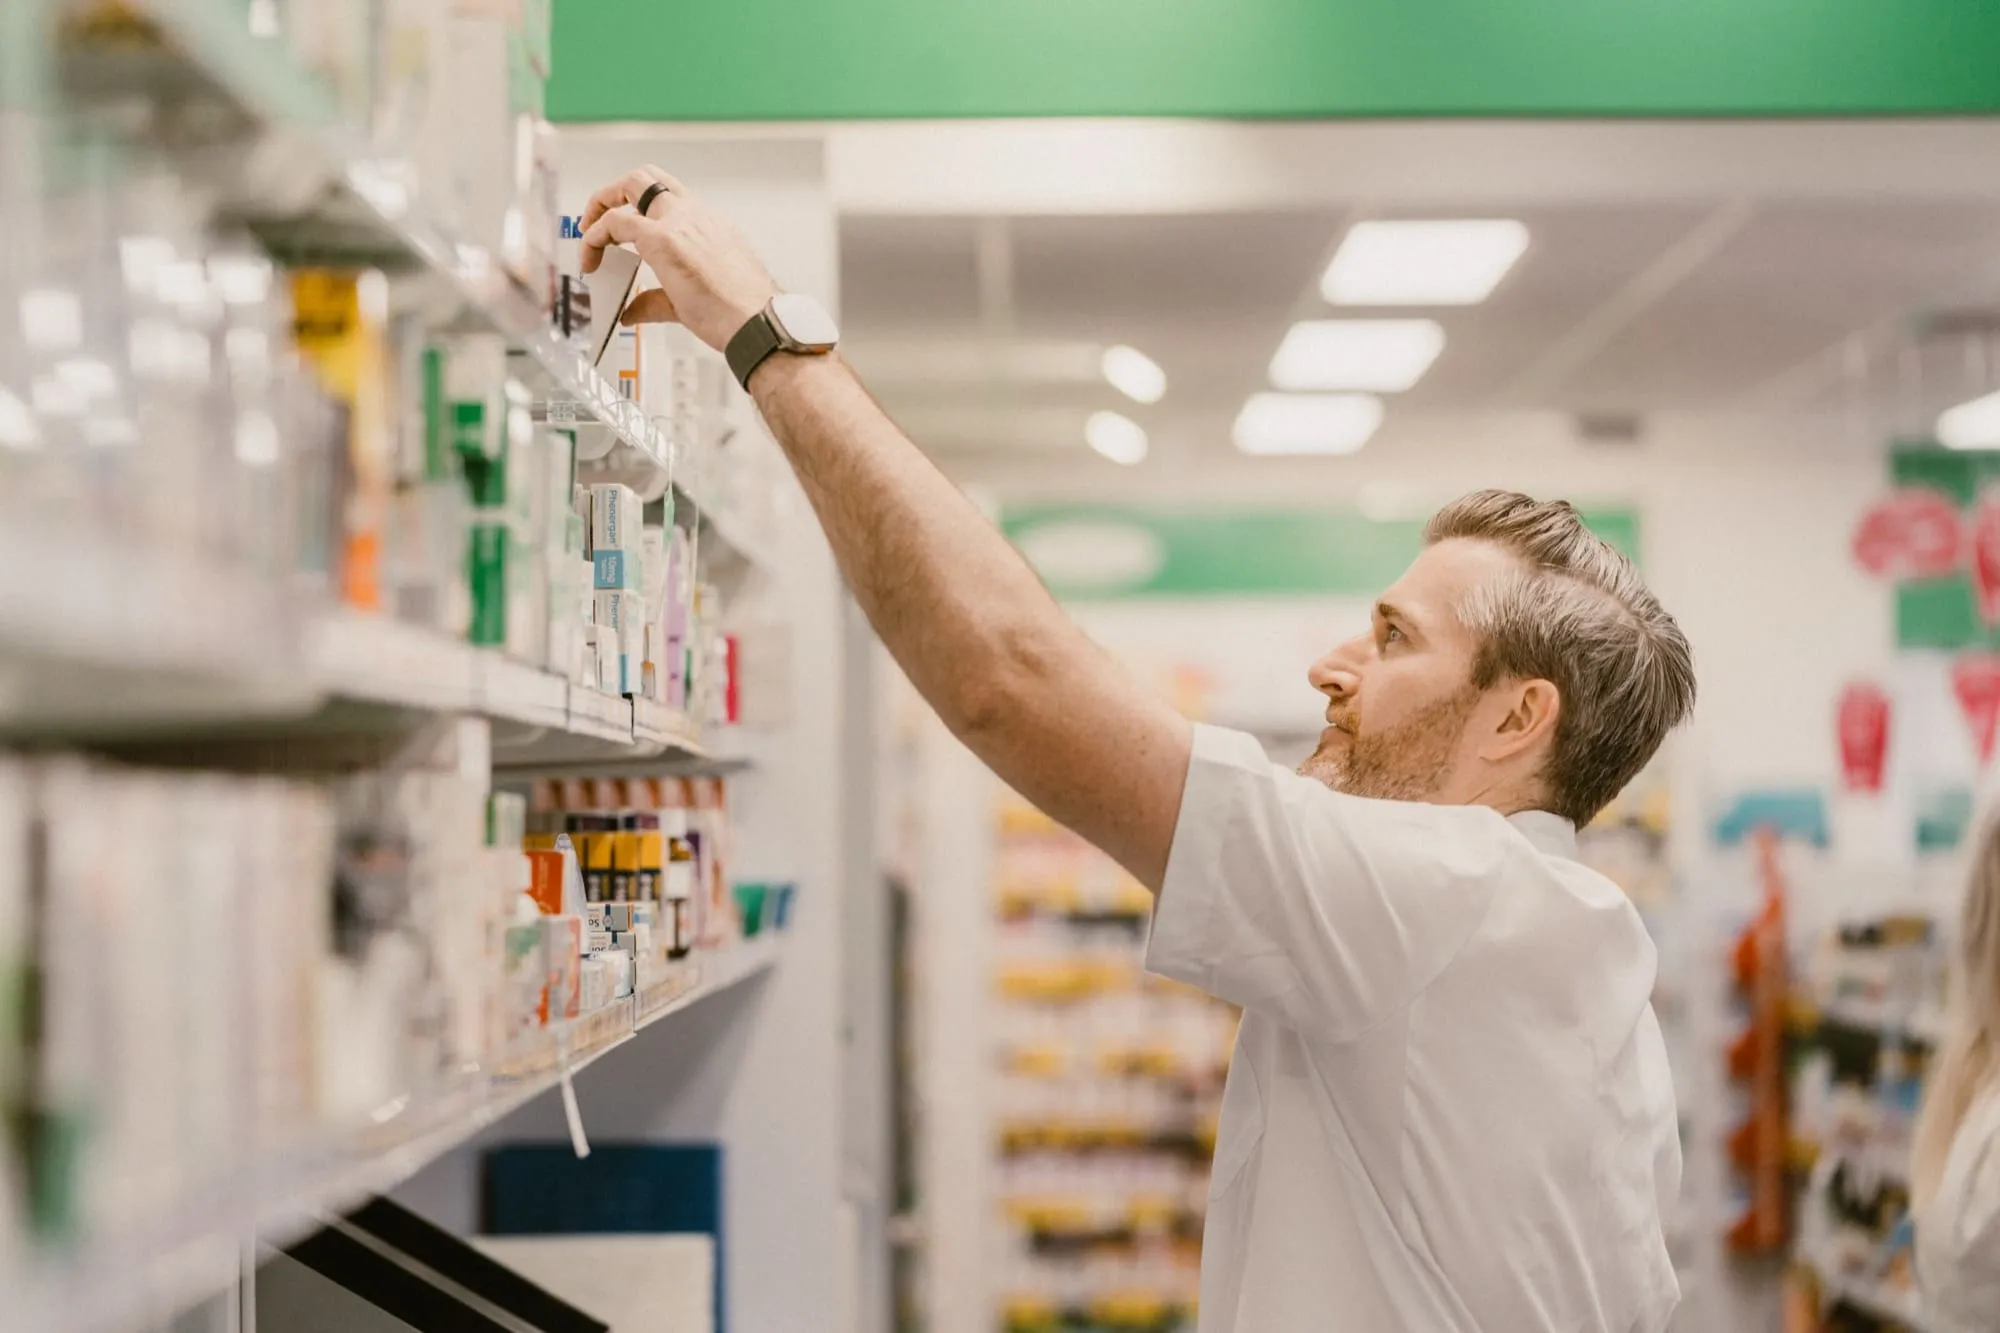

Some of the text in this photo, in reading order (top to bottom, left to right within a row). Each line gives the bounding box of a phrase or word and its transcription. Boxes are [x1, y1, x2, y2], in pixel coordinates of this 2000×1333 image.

[608, 489, 617, 544] Phenergan
[606, 556, 617, 583] 10mg
[610, 593, 619, 632] Phener
